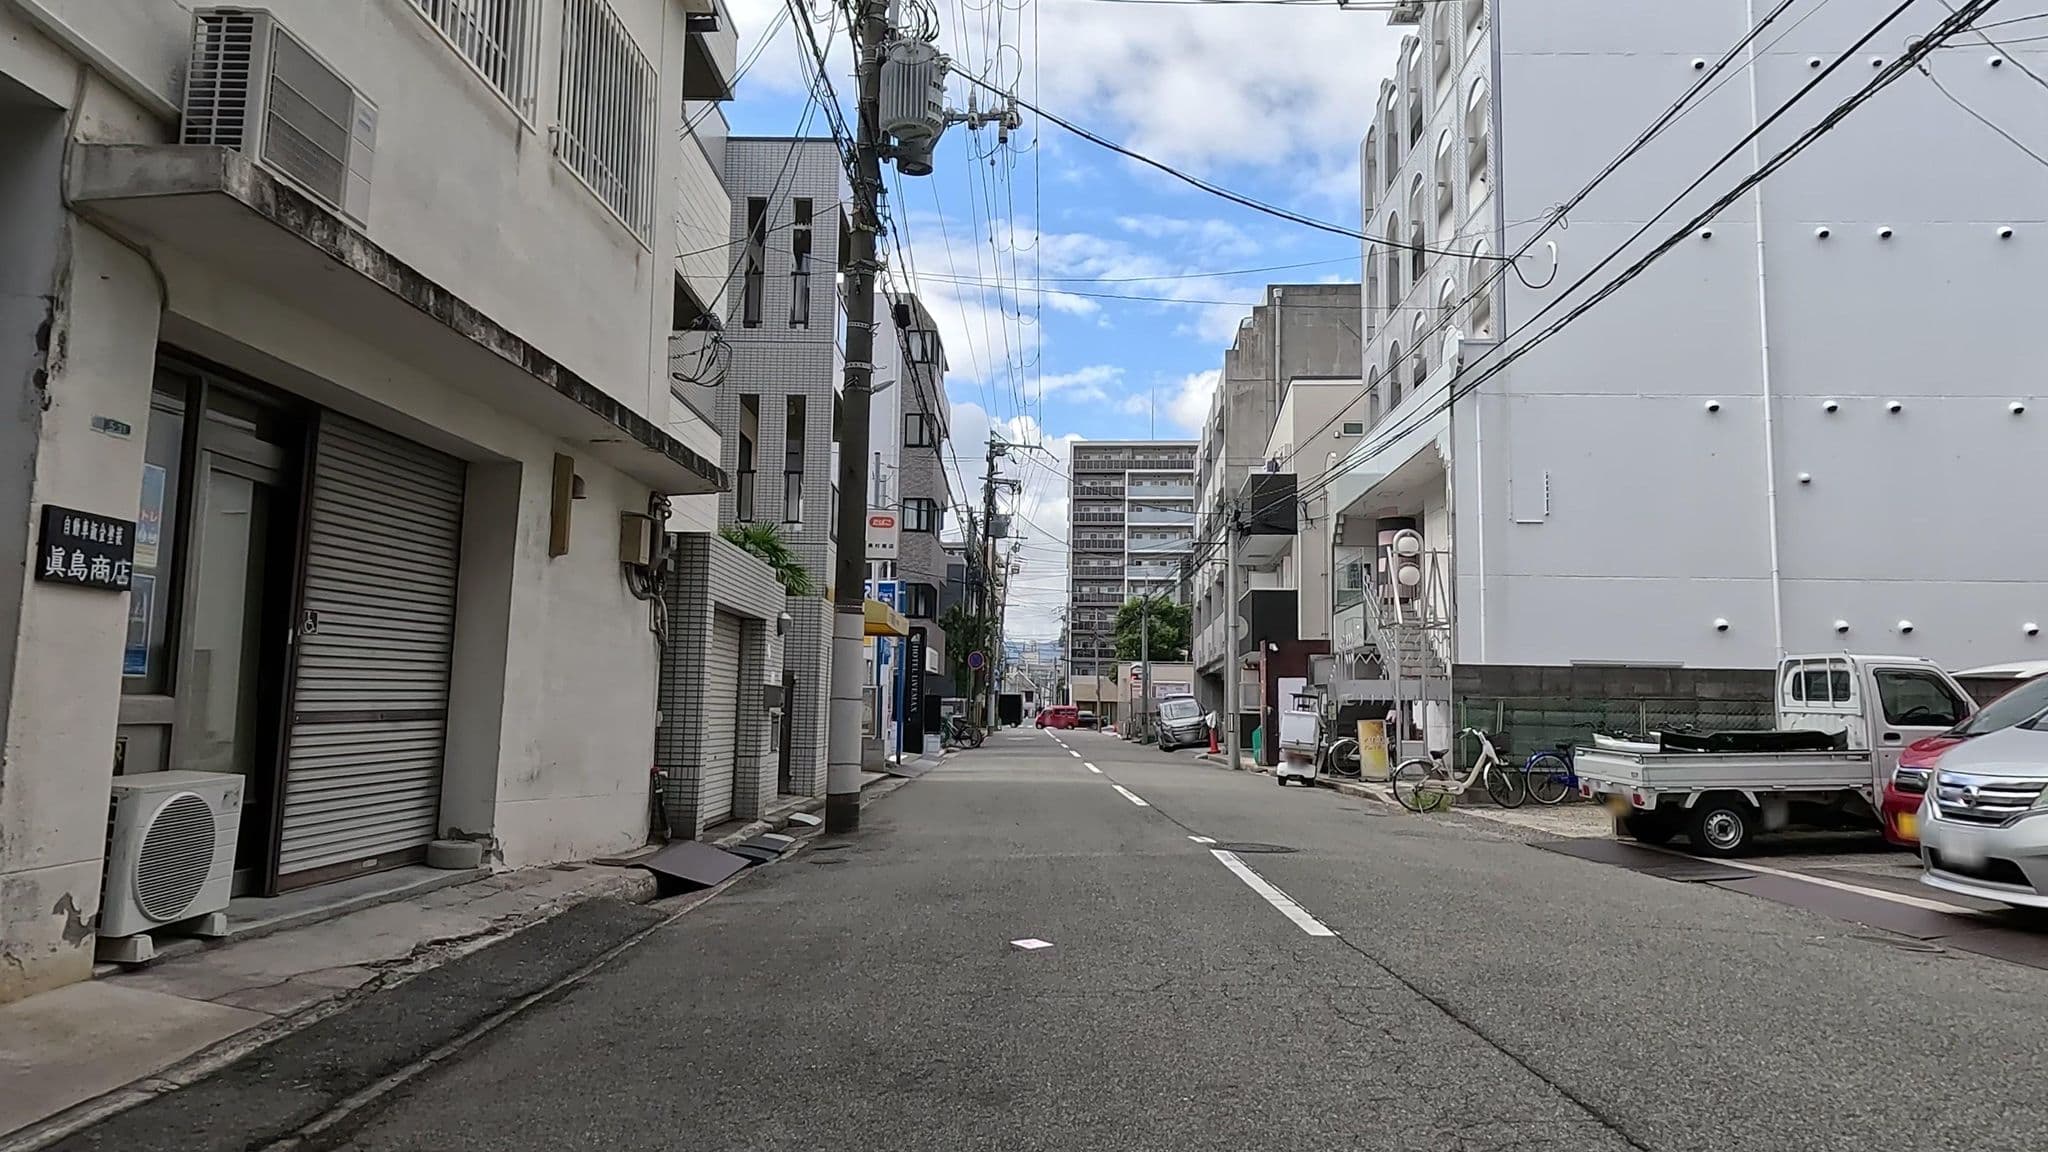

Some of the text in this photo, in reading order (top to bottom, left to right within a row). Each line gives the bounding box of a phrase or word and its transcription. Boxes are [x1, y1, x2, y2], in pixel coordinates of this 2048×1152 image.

[45, 545, 132, 585] 眞島商店
[911, 644, 919, 673] HOTEL
